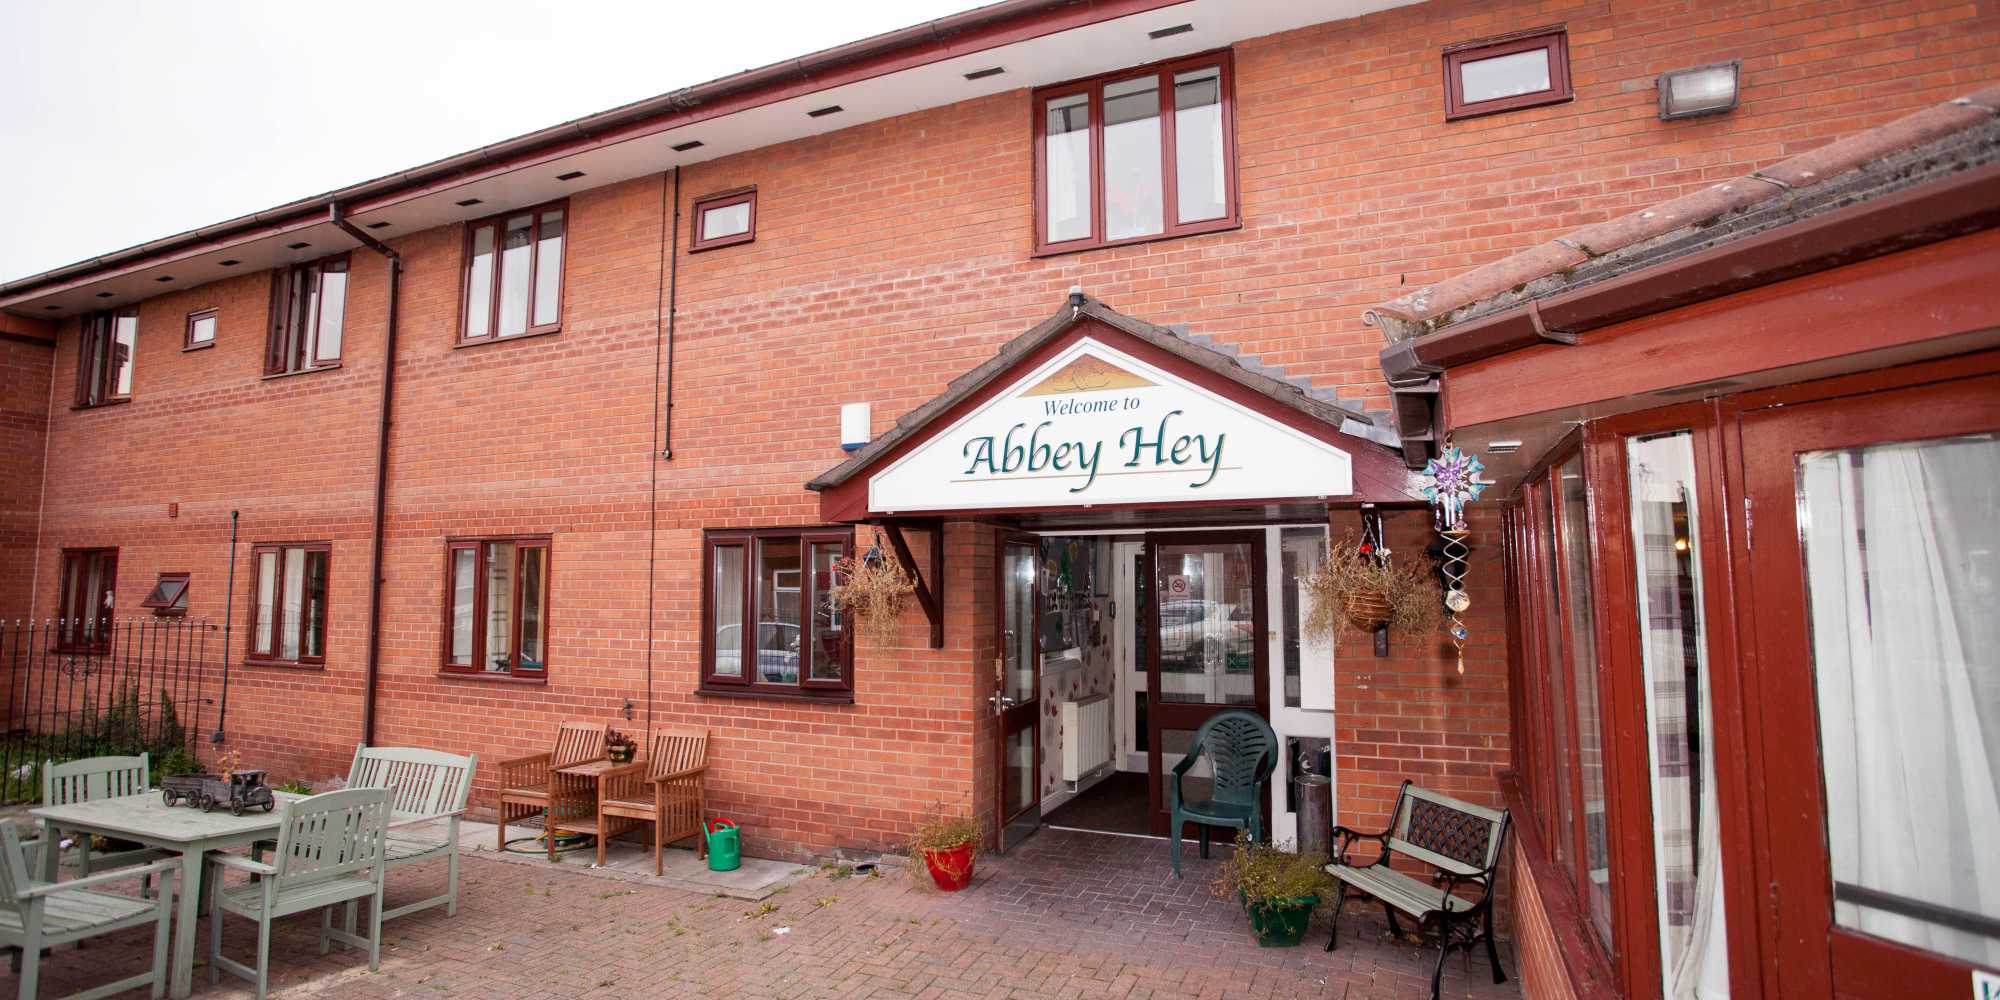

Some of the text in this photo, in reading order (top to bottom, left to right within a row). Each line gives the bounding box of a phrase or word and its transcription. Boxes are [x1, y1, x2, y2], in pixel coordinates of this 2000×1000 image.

[1043, 396, 1140, 416] Welcome to
[963, 410, 1226, 493] Abbey Hey
